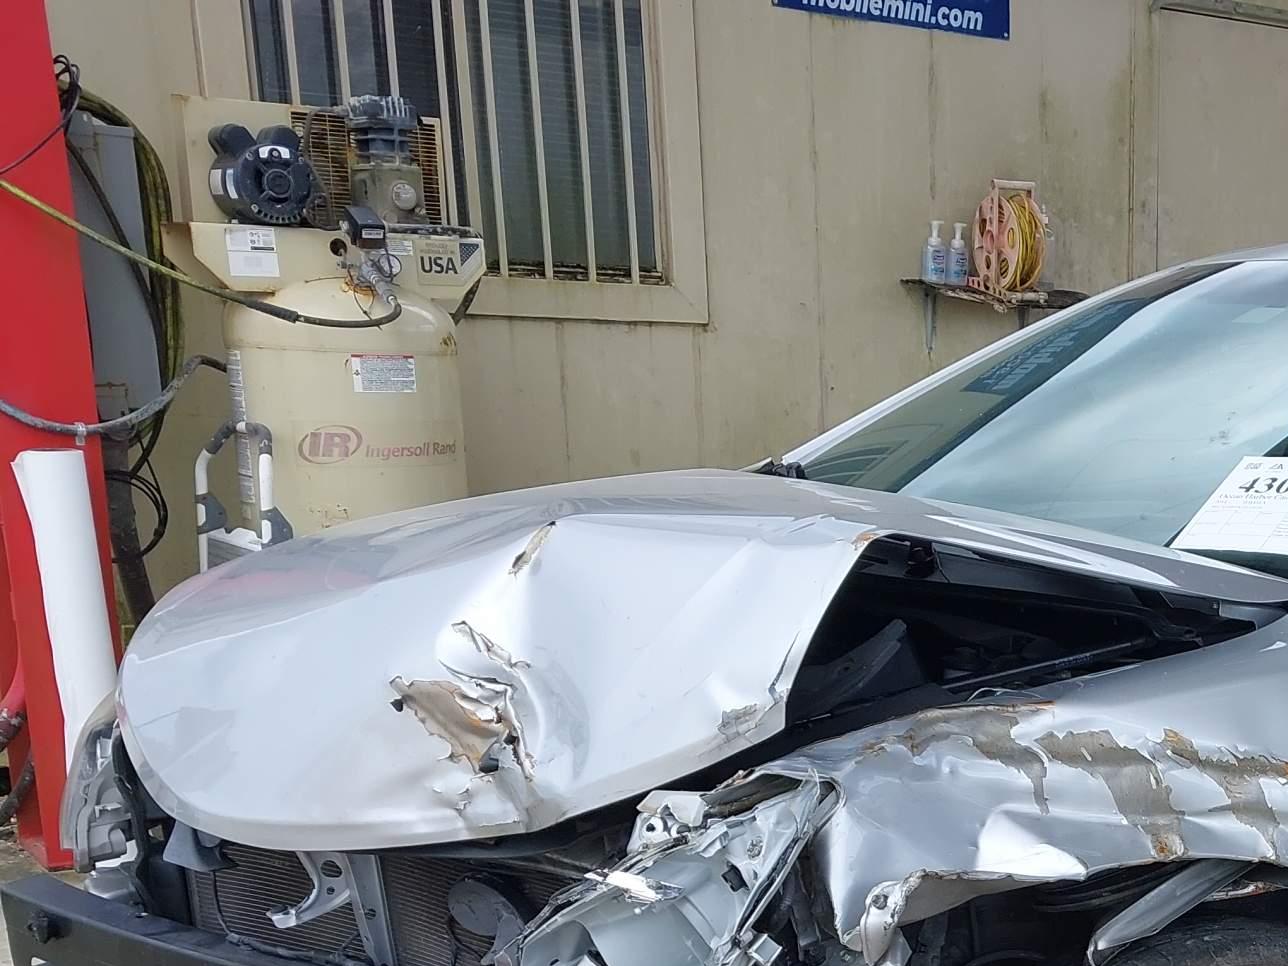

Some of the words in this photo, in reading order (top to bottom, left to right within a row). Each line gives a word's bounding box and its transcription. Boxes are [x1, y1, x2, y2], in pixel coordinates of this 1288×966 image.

[420, 255, 459, 275] USA
[365, 442, 431, 461] Ingersoll
[432, 440, 457, 456] Rand
